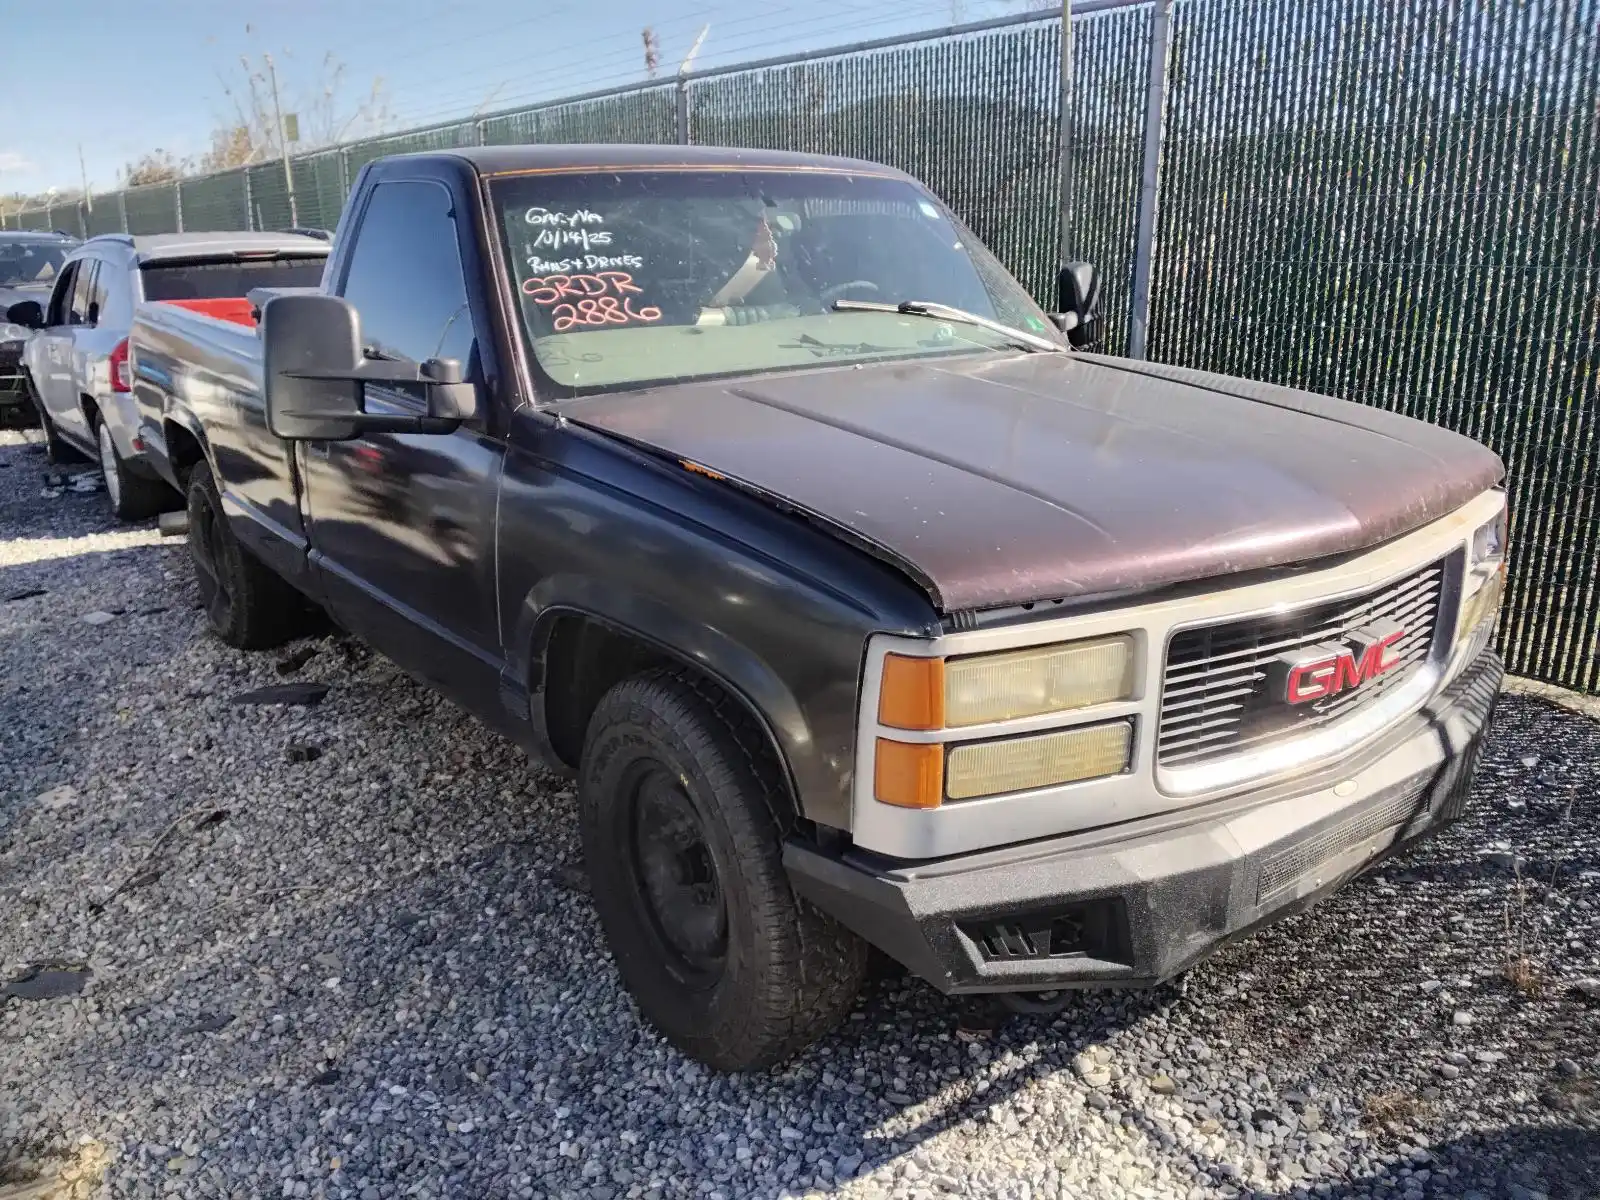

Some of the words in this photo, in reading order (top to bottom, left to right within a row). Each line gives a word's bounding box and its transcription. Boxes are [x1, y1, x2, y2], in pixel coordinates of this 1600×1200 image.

[522, 271, 644, 304] SRDR
[552, 296, 661, 330] 2886
[1286, 630, 1405, 704] GMC
